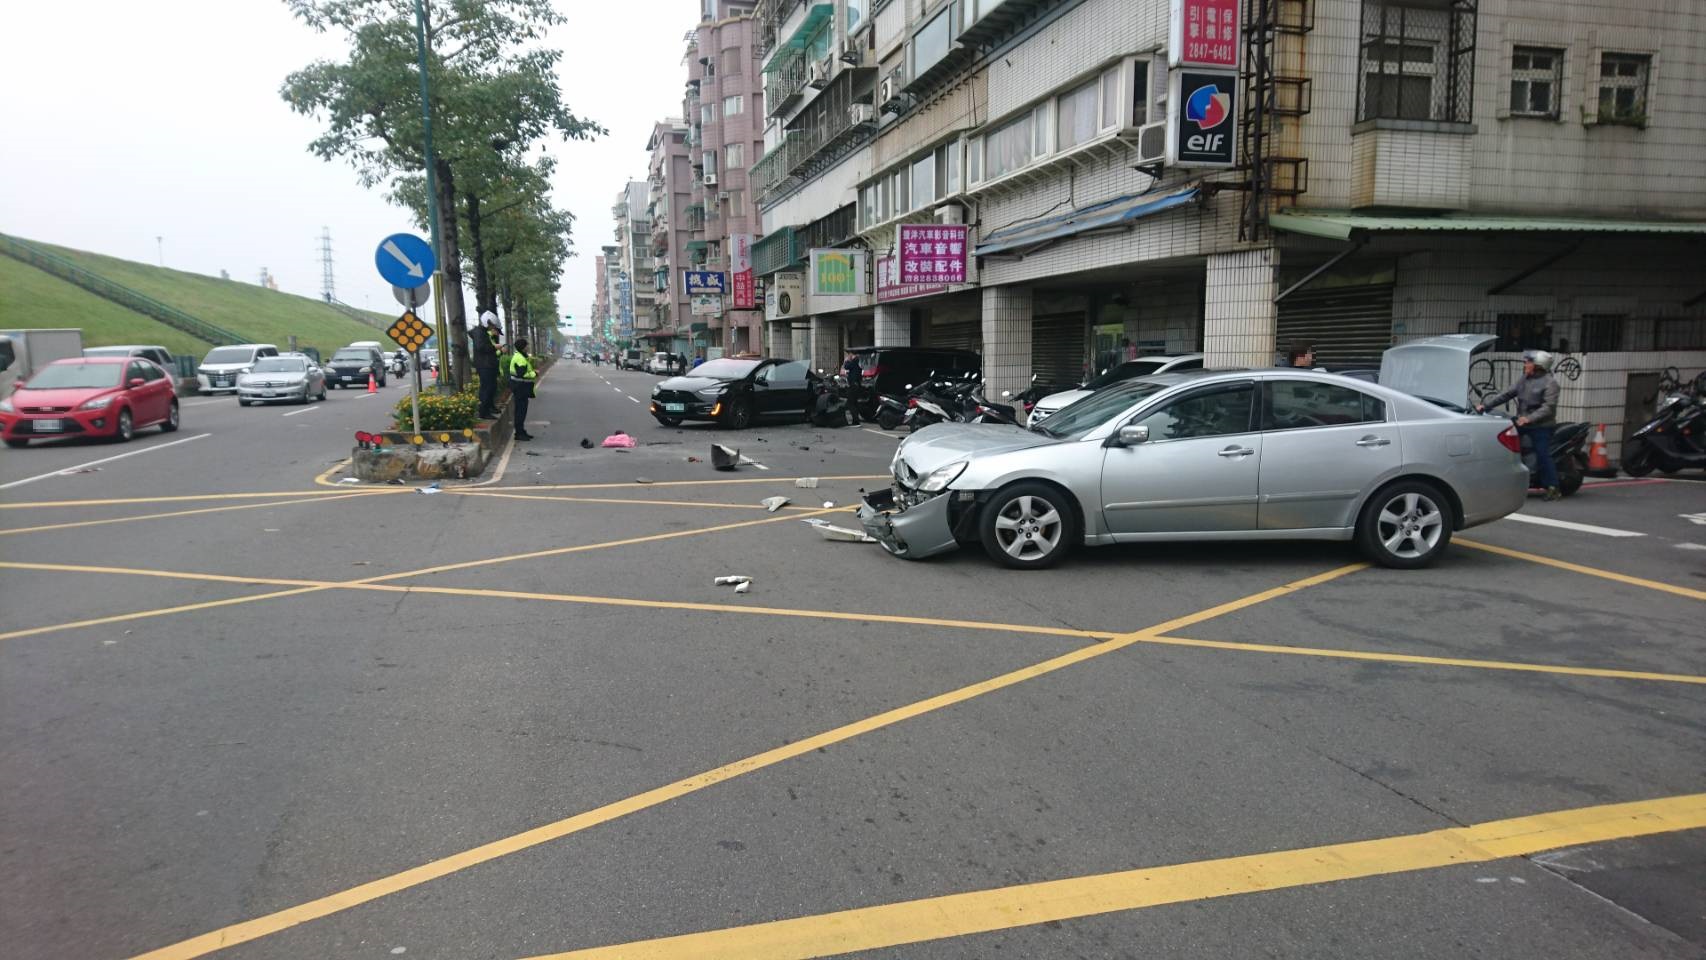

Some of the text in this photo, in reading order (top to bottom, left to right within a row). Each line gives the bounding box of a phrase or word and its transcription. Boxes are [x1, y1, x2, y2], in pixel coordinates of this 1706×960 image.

[1190, 5, 1200, 38] 引擎
[1223, 9, 1233, 41] 保修
[1187, 133, 1224, 152] elf
[904, 242, 963, 255] 汽車音響
[904, 260, 963, 272] 改裝配件
